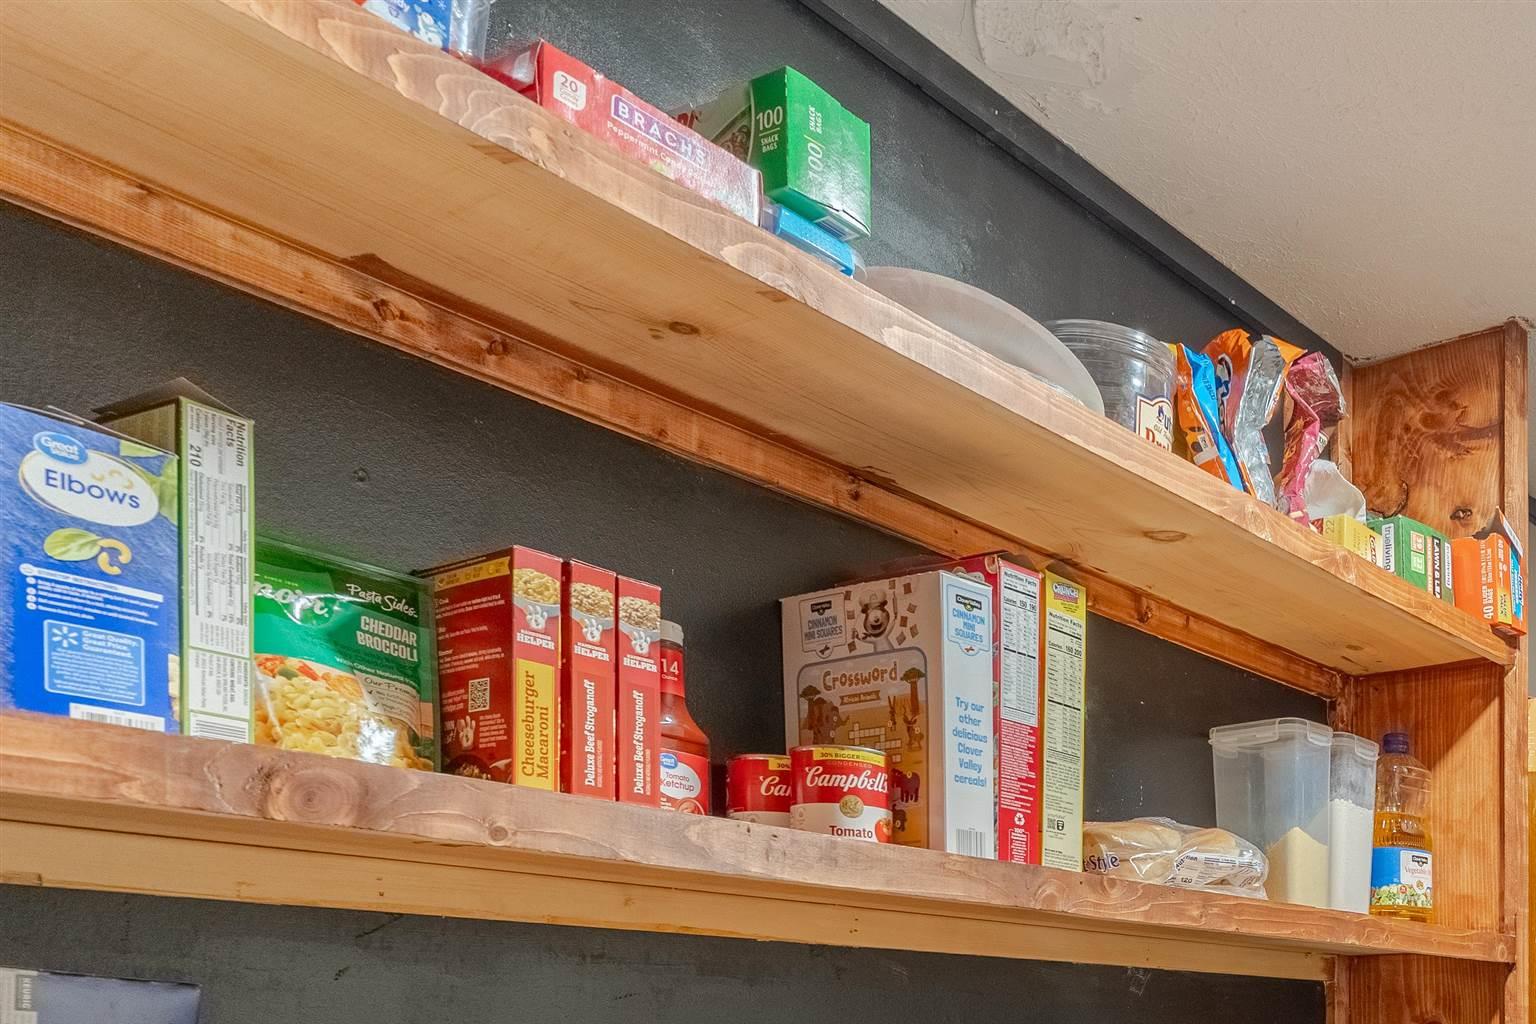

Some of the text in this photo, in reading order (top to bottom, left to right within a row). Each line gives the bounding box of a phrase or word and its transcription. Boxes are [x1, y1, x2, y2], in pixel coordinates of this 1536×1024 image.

[561, 75, 578, 92] 20
[756, 105, 784, 131] 100
[807, 104, 816, 132] SNACK
[760, 133, 779, 146] SNACK
[762, 142, 778, 153] BAGS
[807, 141, 824, 182] 100
[225, 418, 236, 448] Facts
[235, 421, 248, 467] Nutrition
[189, 443, 202, 468] 210
[44, 467, 141, 510] Elbows
[1433, 539, 1441, 568] LAWN
[345, 582, 383, 605] Pasta
[382, 595, 417, 616] Sides
[951, 607, 986, 626] CINNAMON
[1482, 605, 1495, 619] 40
[359, 614, 418, 648] CHEDDAR
[807, 615, 838, 630] CINNAMON
[962, 621, 976, 632] MINI
[515, 632, 556, 651] HELPER
[816, 625, 843, 640] SQUARES
[954, 628, 984, 643] SQUARES
[355, 630, 419, 663] BROCCOLI
[573, 644, 610, 662] HELPER
[623, 656, 658, 673] HELPER
[660, 658, 680, 675] 14
[821, 660, 899, 692] Crossword
[955, 696, 985, 714] Try our
[521, 670, 539, 778] Cheeseburger
[958, 714, 983, 728] other
[535, 705, 550, 780] Macaroni
[583, 679, 598, 787] Deluxe Beef Stroganoff
[632, 689, 646, 795] Deluxe Beef Stroganoff
[952, 726, 988, 744] delicious
[834, 752, 861, 760] BIGGER
[957, 742, 984, 757] Clover
[958, 757, 983, 774] Valley
[665, 771, 690, 783] Tomato
[804, 765, 889, 794] Campbell's
[953, 774, 988, 788] cereals!
[828, 824, 874, 839] Tomato
[1089, 854, 1121, 873] Style
[22, 977, 32, 1010] KEURIG
